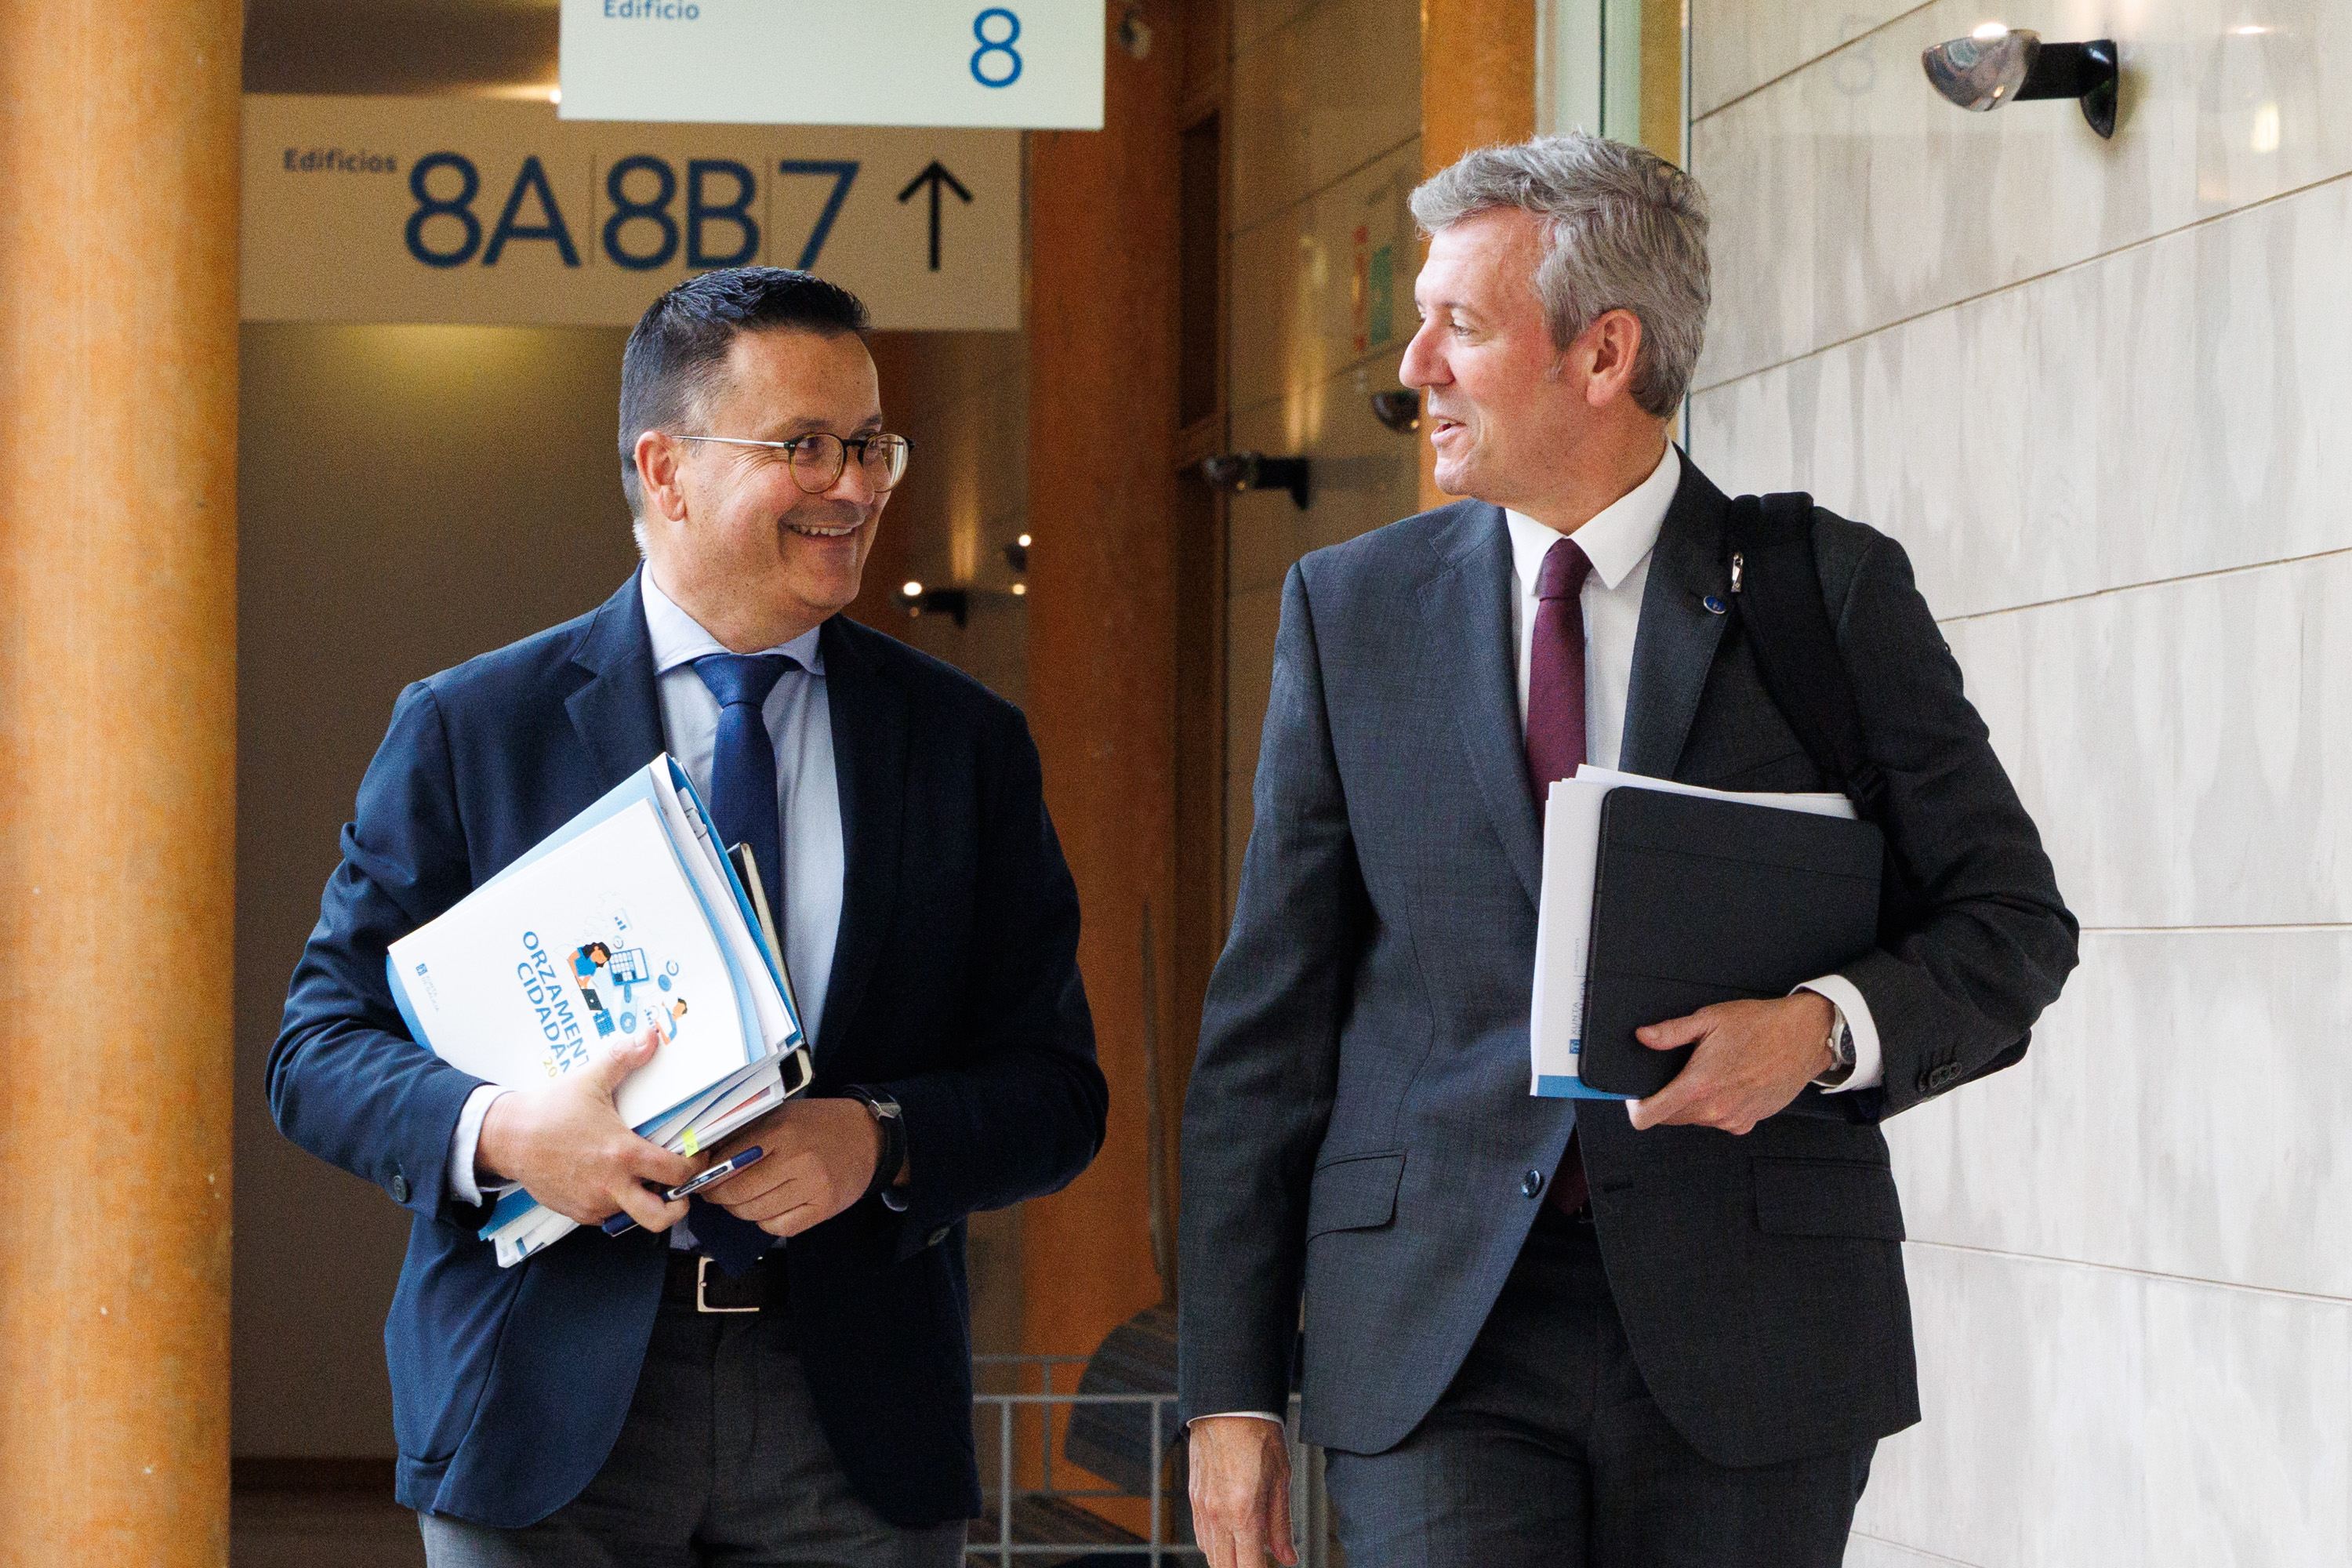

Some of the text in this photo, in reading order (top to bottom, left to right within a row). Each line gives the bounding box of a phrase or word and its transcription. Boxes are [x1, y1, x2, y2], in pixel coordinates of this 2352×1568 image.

[604, 0, 700, 20] Edificio
[970, 8, 1022, 88] 8
[283, 147, 860, 271] Edificios 8A 8B 7
[426, 974, 438, 997] XUNTA
[426, 986, 440, 1012] GALICIA
[1570, 1002, 1579, 1036] XUNTA
